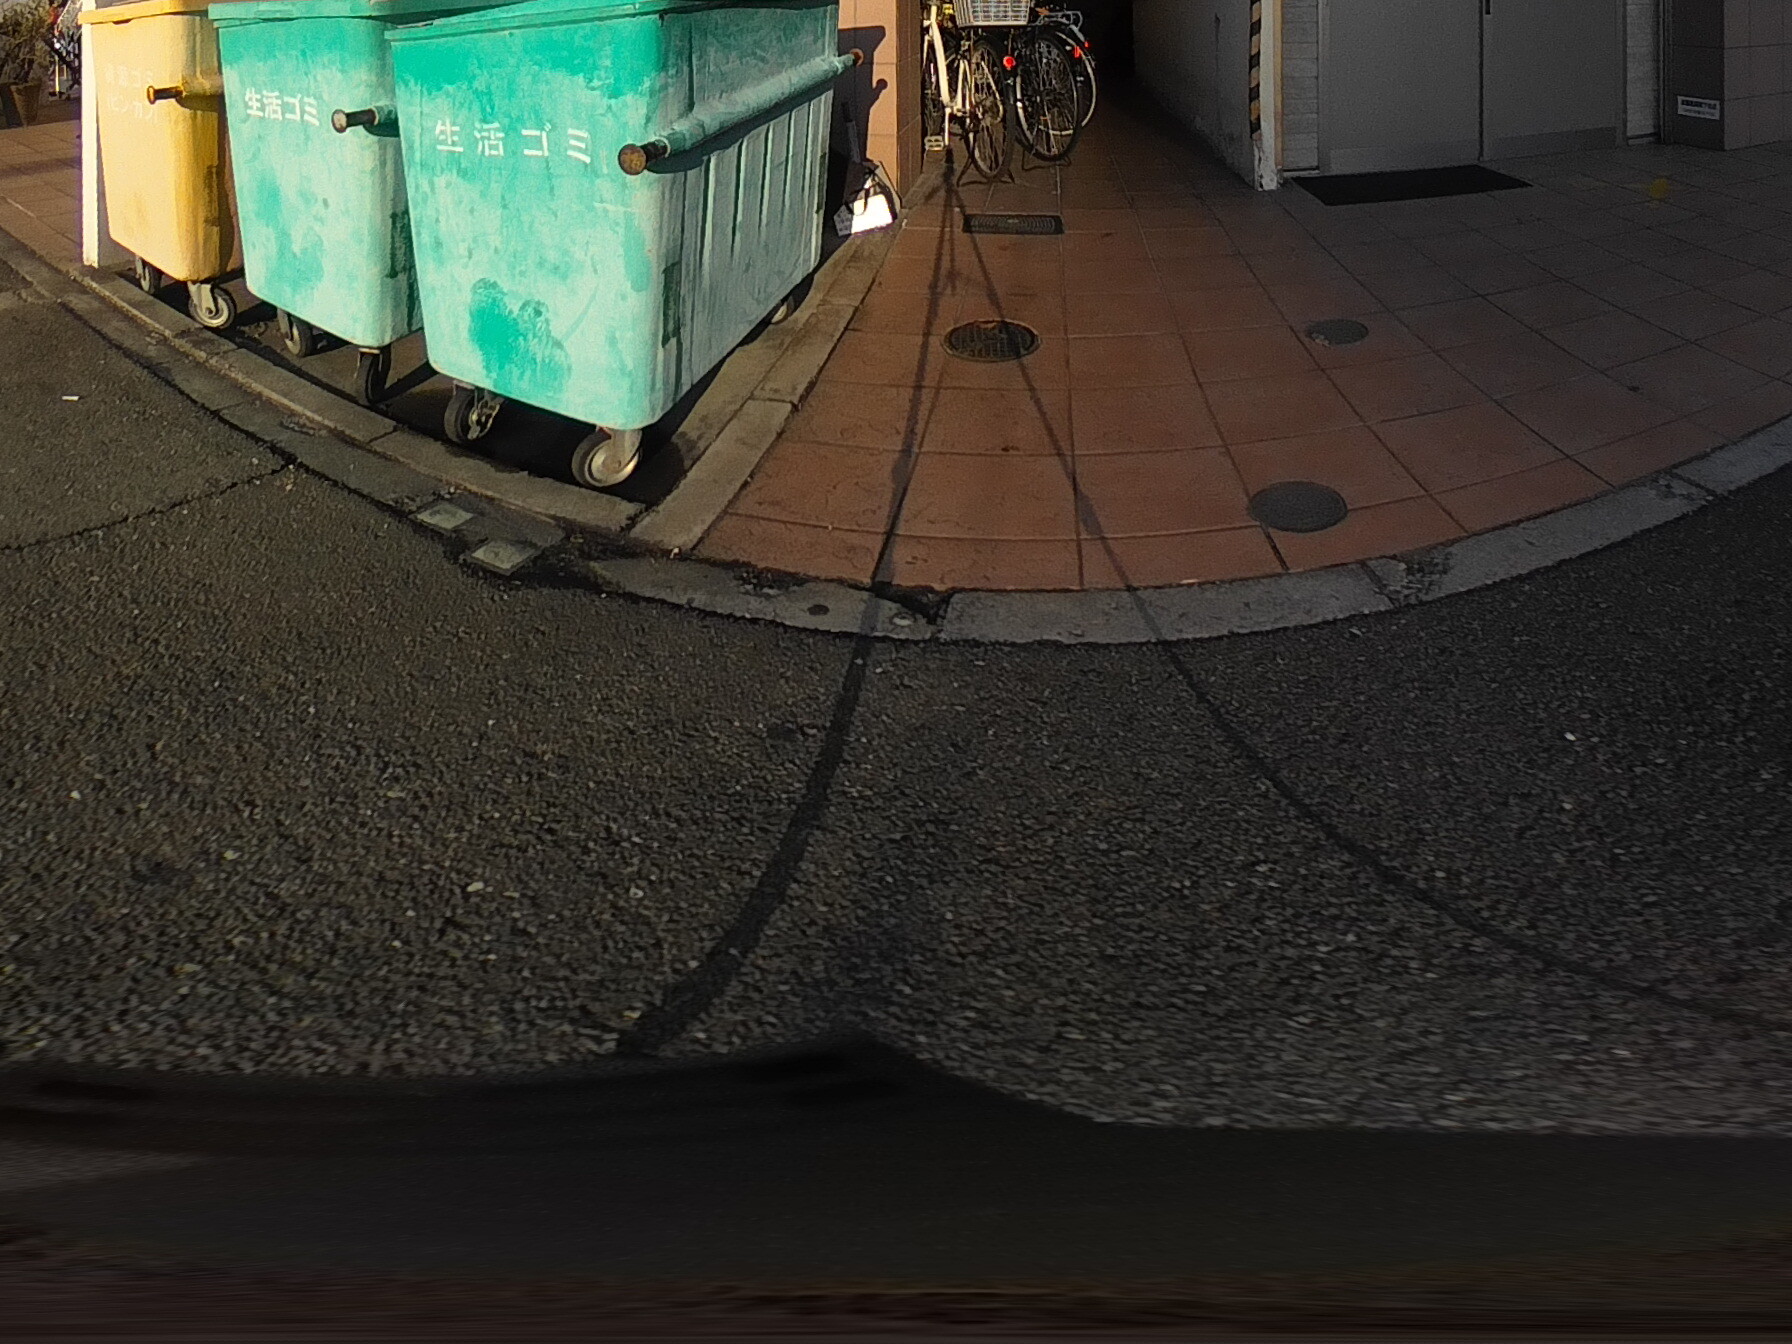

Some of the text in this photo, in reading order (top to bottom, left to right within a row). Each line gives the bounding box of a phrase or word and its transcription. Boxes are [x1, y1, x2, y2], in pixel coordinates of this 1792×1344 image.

[245, 87, 320, 127] 生活ゴミ
[435, 119, 592, 165] 生活ゴミ
